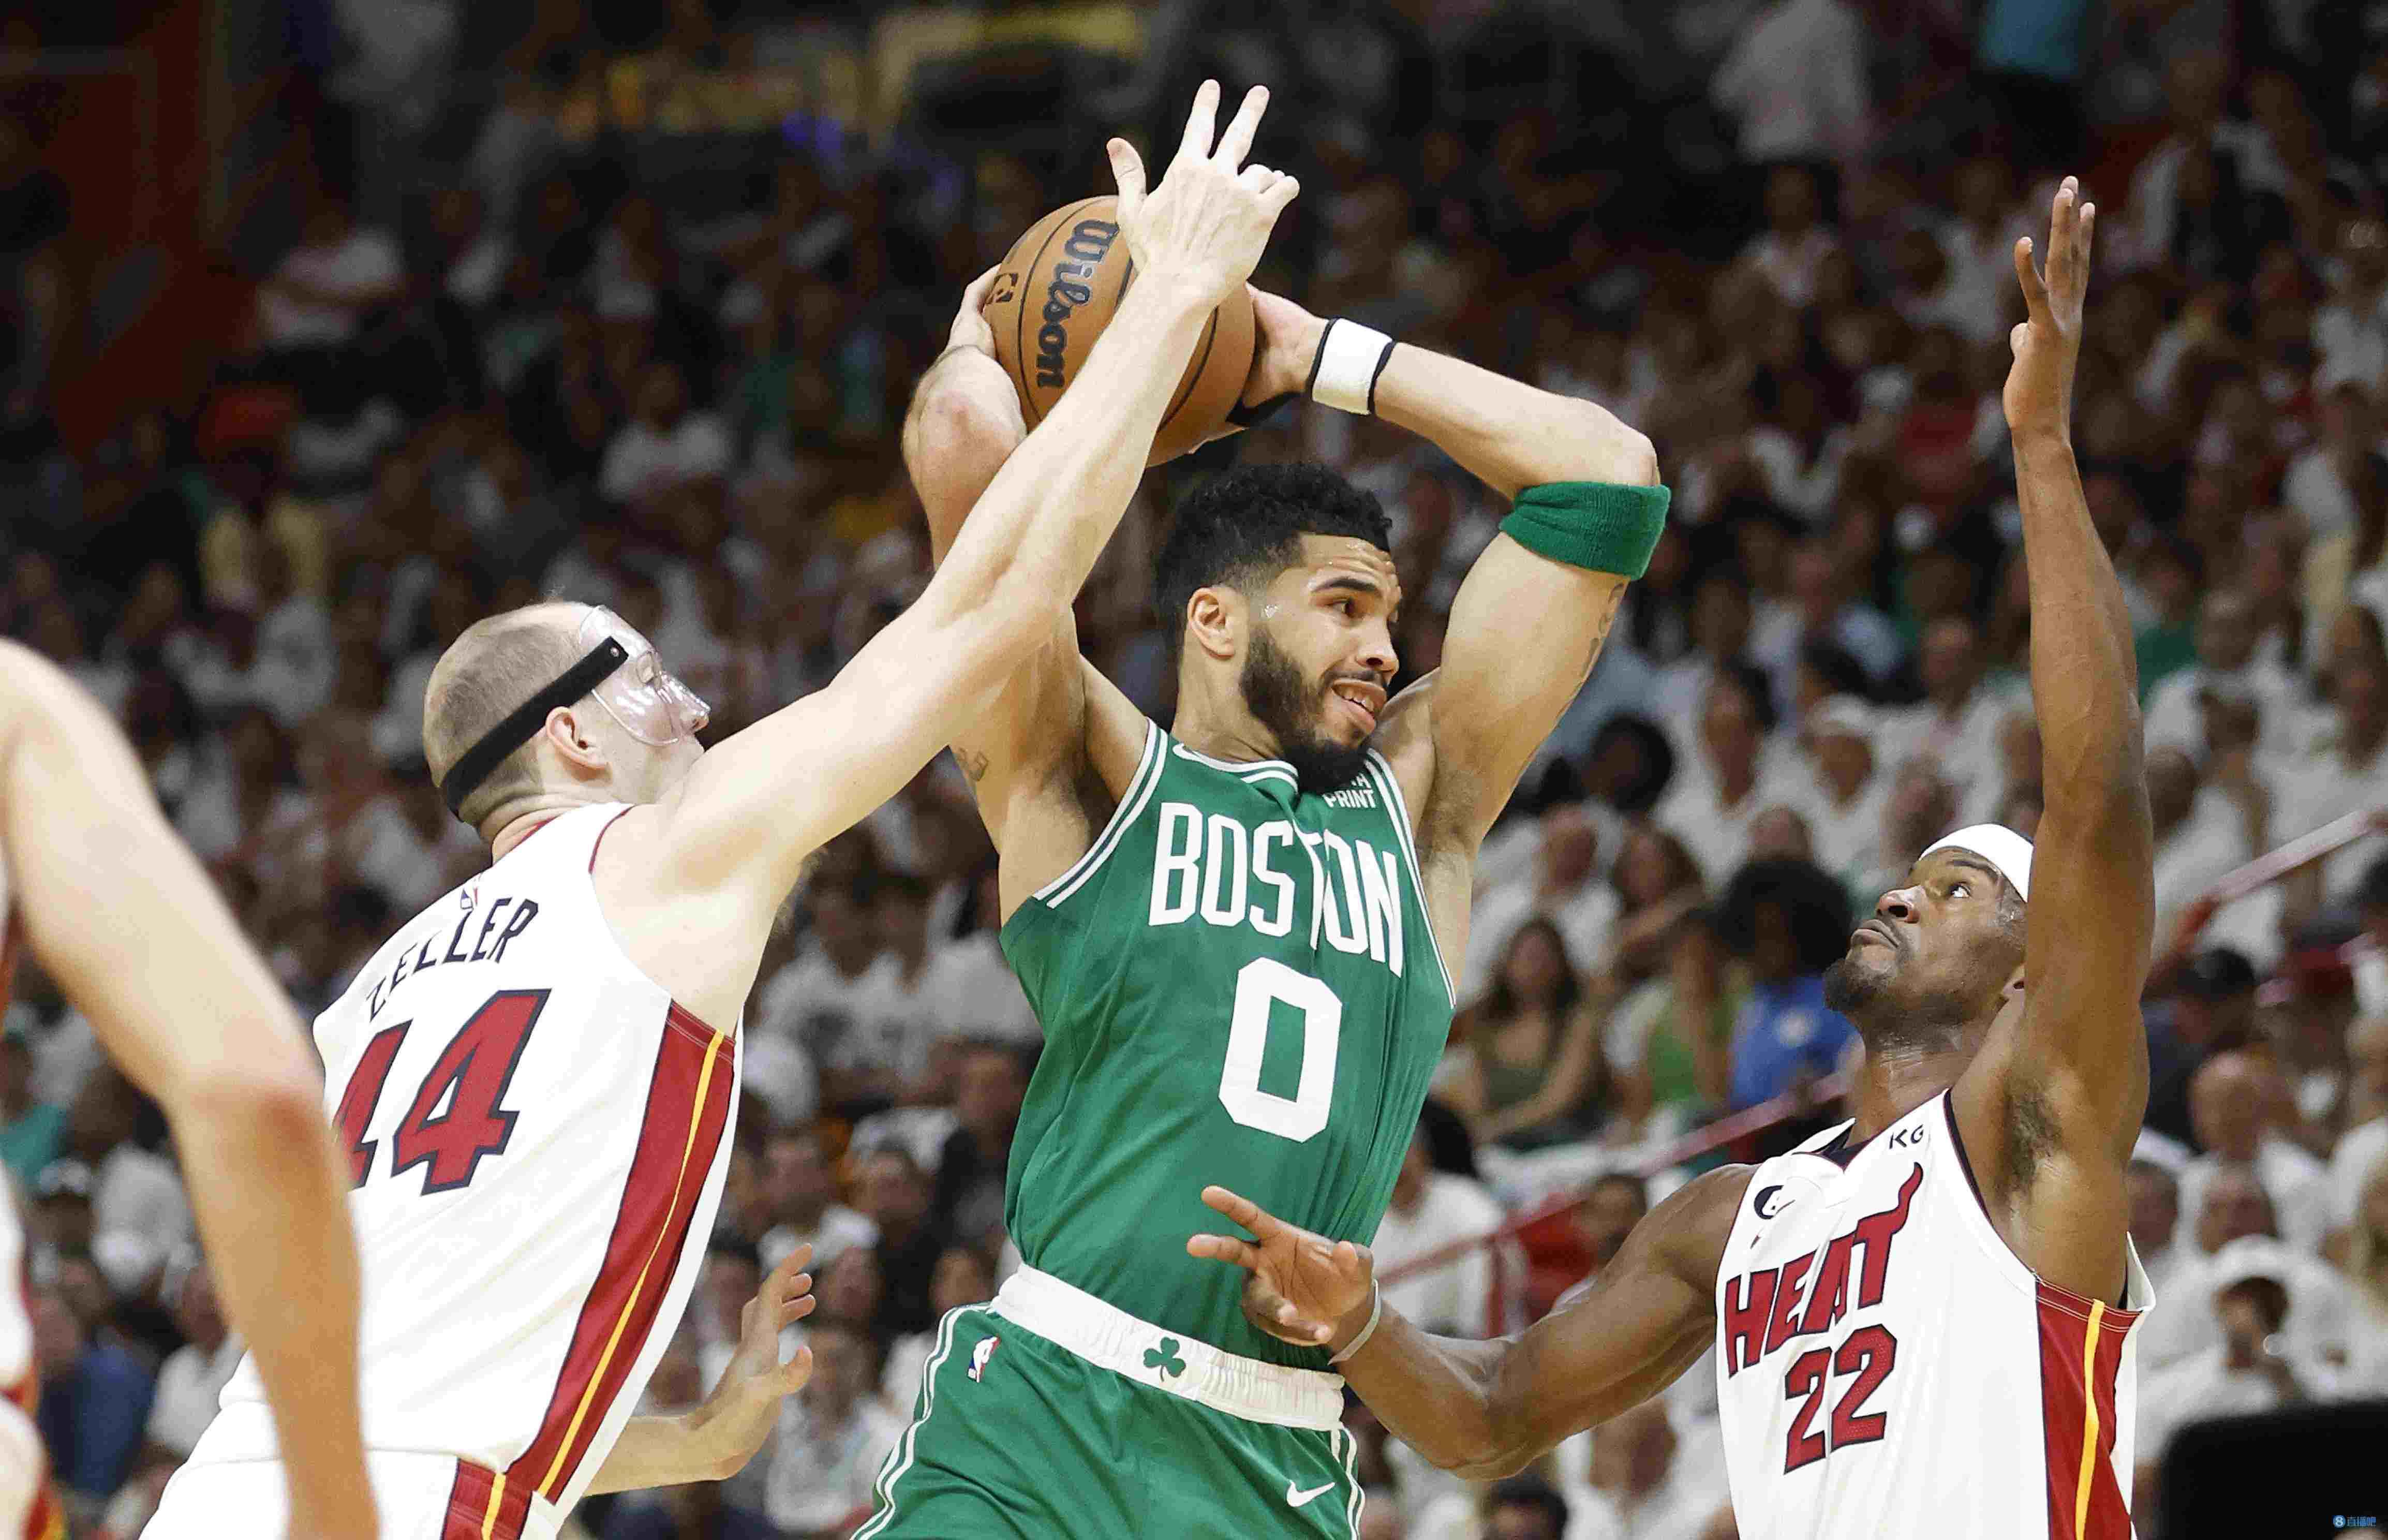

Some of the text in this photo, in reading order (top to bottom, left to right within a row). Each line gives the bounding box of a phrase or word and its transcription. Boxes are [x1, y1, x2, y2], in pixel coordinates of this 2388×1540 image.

[1036, 219, 1120, 388] Wilson
[1322, 789, 1376, 808] PRINT
[366, 896, 539, 1023] ZELLER
[1148, 802, 1404, 979] BOSTON
[1219, 957, 1343, 1144] 0
[1889, 1124, 1924, 1150] KG
[1724, 1162, 1924, 1380] HEAT
[1784, 1323, 1897, 1475] 22
